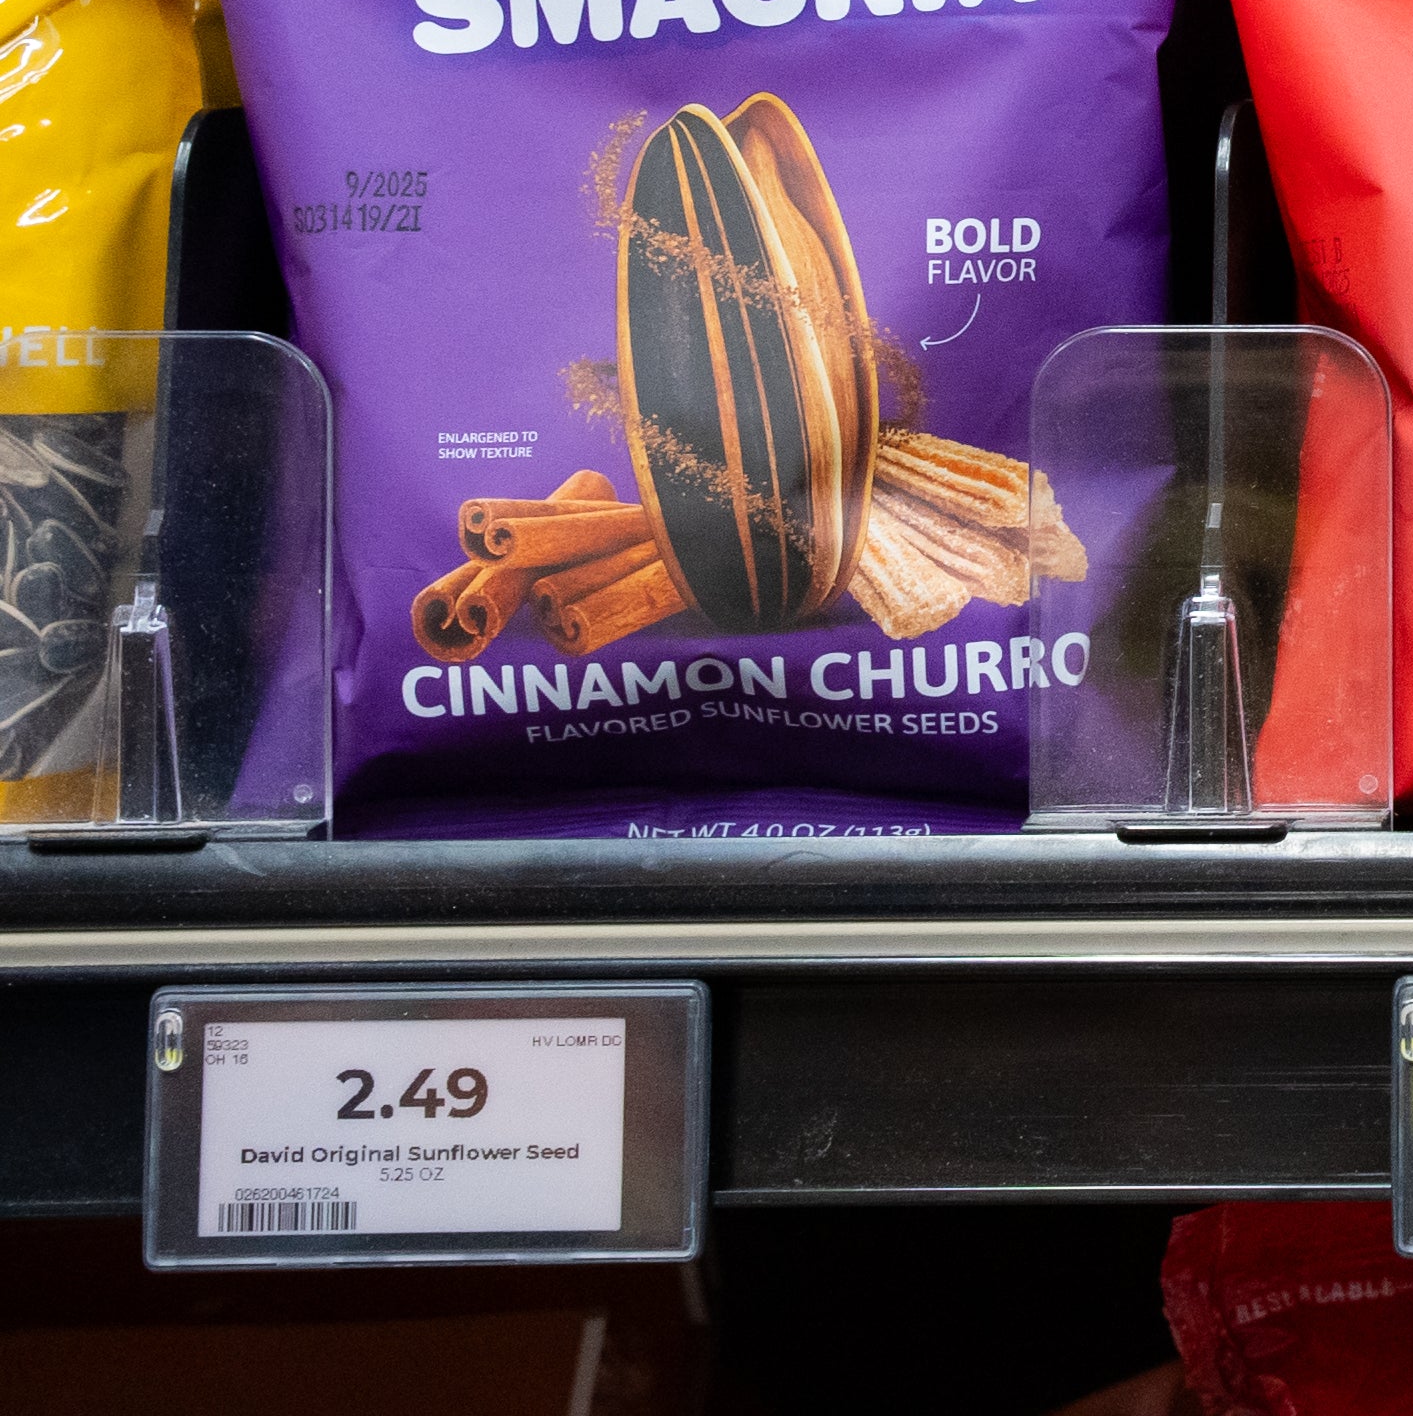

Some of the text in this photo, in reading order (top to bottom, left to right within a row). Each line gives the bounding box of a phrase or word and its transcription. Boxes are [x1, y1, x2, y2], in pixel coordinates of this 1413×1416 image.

[345, 170, 429, 199] 9/2025
[925, 216, 1041, 255] BOLD
[926, 256, 1038, 287] FLAVOR
[437, 430, 538, 444] ENLARGENED TO
[438, 446, 533, 459] SHOW TEXTURE
[401, 631, 1091, 719] CINNAMON CHURRO
[526, 699, 1000, 745] FLAVORED SUNFLOWER SEEDS
[207, 1025, 224, 1038] 12
[532, 1034, 623, 1048] HV LOMR DC
[204, 1053, 226, 1066] OH
[335, 1067, 489, 1120] 2.49
[240, 1143, 580, 1168] David Original Sunflower Seed
[378, 1166, 445, 1182] 5.25 OZ
